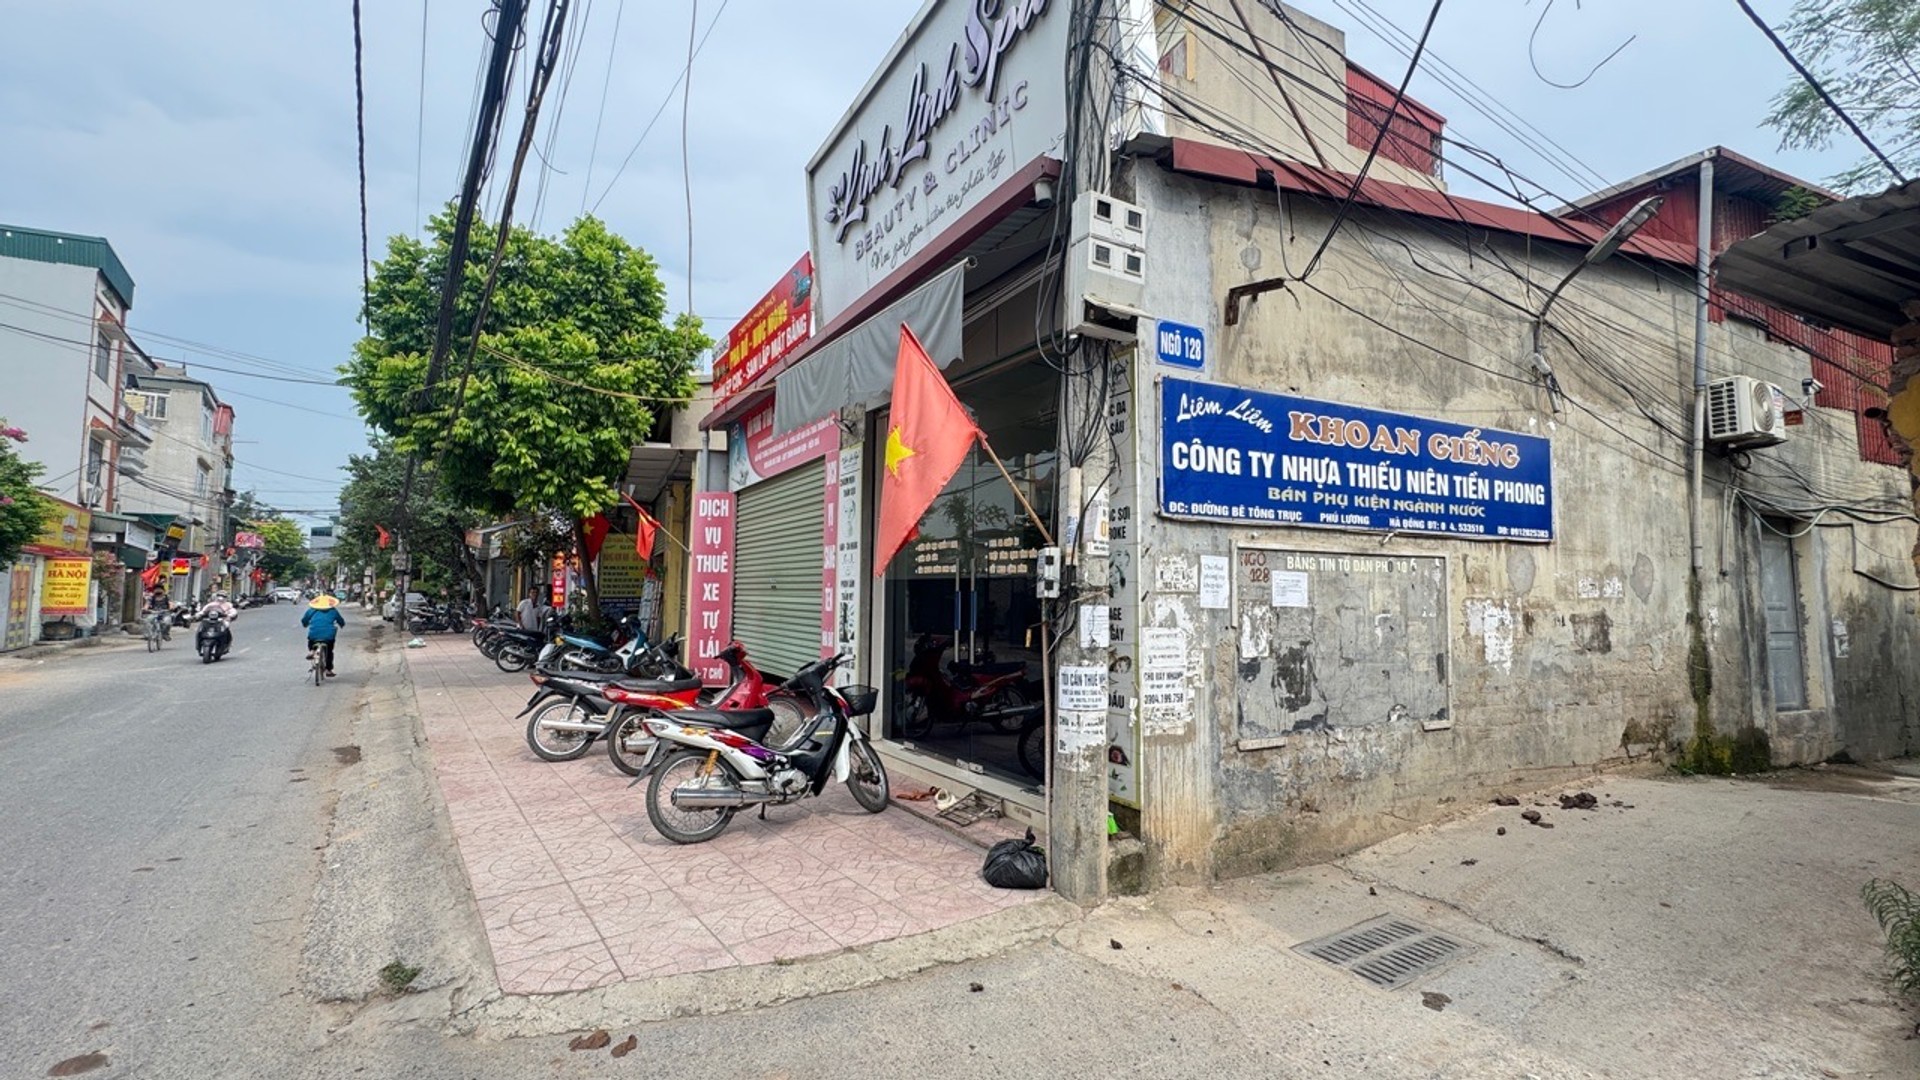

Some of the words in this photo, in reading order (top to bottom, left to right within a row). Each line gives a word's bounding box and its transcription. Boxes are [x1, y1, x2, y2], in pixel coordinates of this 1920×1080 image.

[835, 125, 892, 244] Linh
[889, 42, 960, 188] Linh
[963, 0, 1049, 103] Spa
[856, 186, 917, 260] BEAUTY
[923, 171, 939, 196] &
[945, 81, 1029, 174] CLINIC
[1160, 330, 1181, 356] NGÕ
[1184, 336, 1201, 360] 128
[1176, 393, 1223, 423] Liêm
[1226, 398, 1274, 434] Liêm
[1288, 411, 1421, 457] KHOAN
[1428, 428, 1520, 469] GIẾNG
[1172, 438, 1241, 475] CÔNG
[1248, 451, 1275, 478] TY
[1282, 456, 1342, 489] NHỰA
[1346, 459, 1400, 492] THIẾU
[1406, 468, 1449, 497] NIÊN
[1453, 471, 1489, 500] TIỀN
[1494, 479, 1545, 506] PHONG
[699, 499, 729, 521] DỊCH
[1169, 501, 1189, 514] ĐC:
[1191, 500, 1229, 516] ĐƯỜNG
[1248, 507, 1275, 521] TÔNG
[1277, 509, 1302, 523] TRỤC
[1320, 511, 1338, 524] PHÚ
[1341, 513, 1370, 525] LƯƠNG
[1389, 516, 1400, 527] HÀ
[1268, 486, 1306, 503] BÁN
[1313, 492, 1349, 509] PHỤ
[1354, 494, 1390, 510] KIỆN
[1393, 498, 1445, 515] NGÀNH
[1449, 501, 1486, 518] NƯỚC
[705, 527, 722, 549] VỤ
[696, 551, 729, 573] THUÊ
[1319, 557, 1336, 572] TIN
[47, 569, 65, 578] HÀ
[66, 569, 87, 580] NỘI
[1250, 567, 1270, 583] 128
[703, 583, 720, 601] XE
[702, 610, 720, 634] TỰ
[699, 636, 719, 658] LÁI
[702, 667, 707, 679] 7
